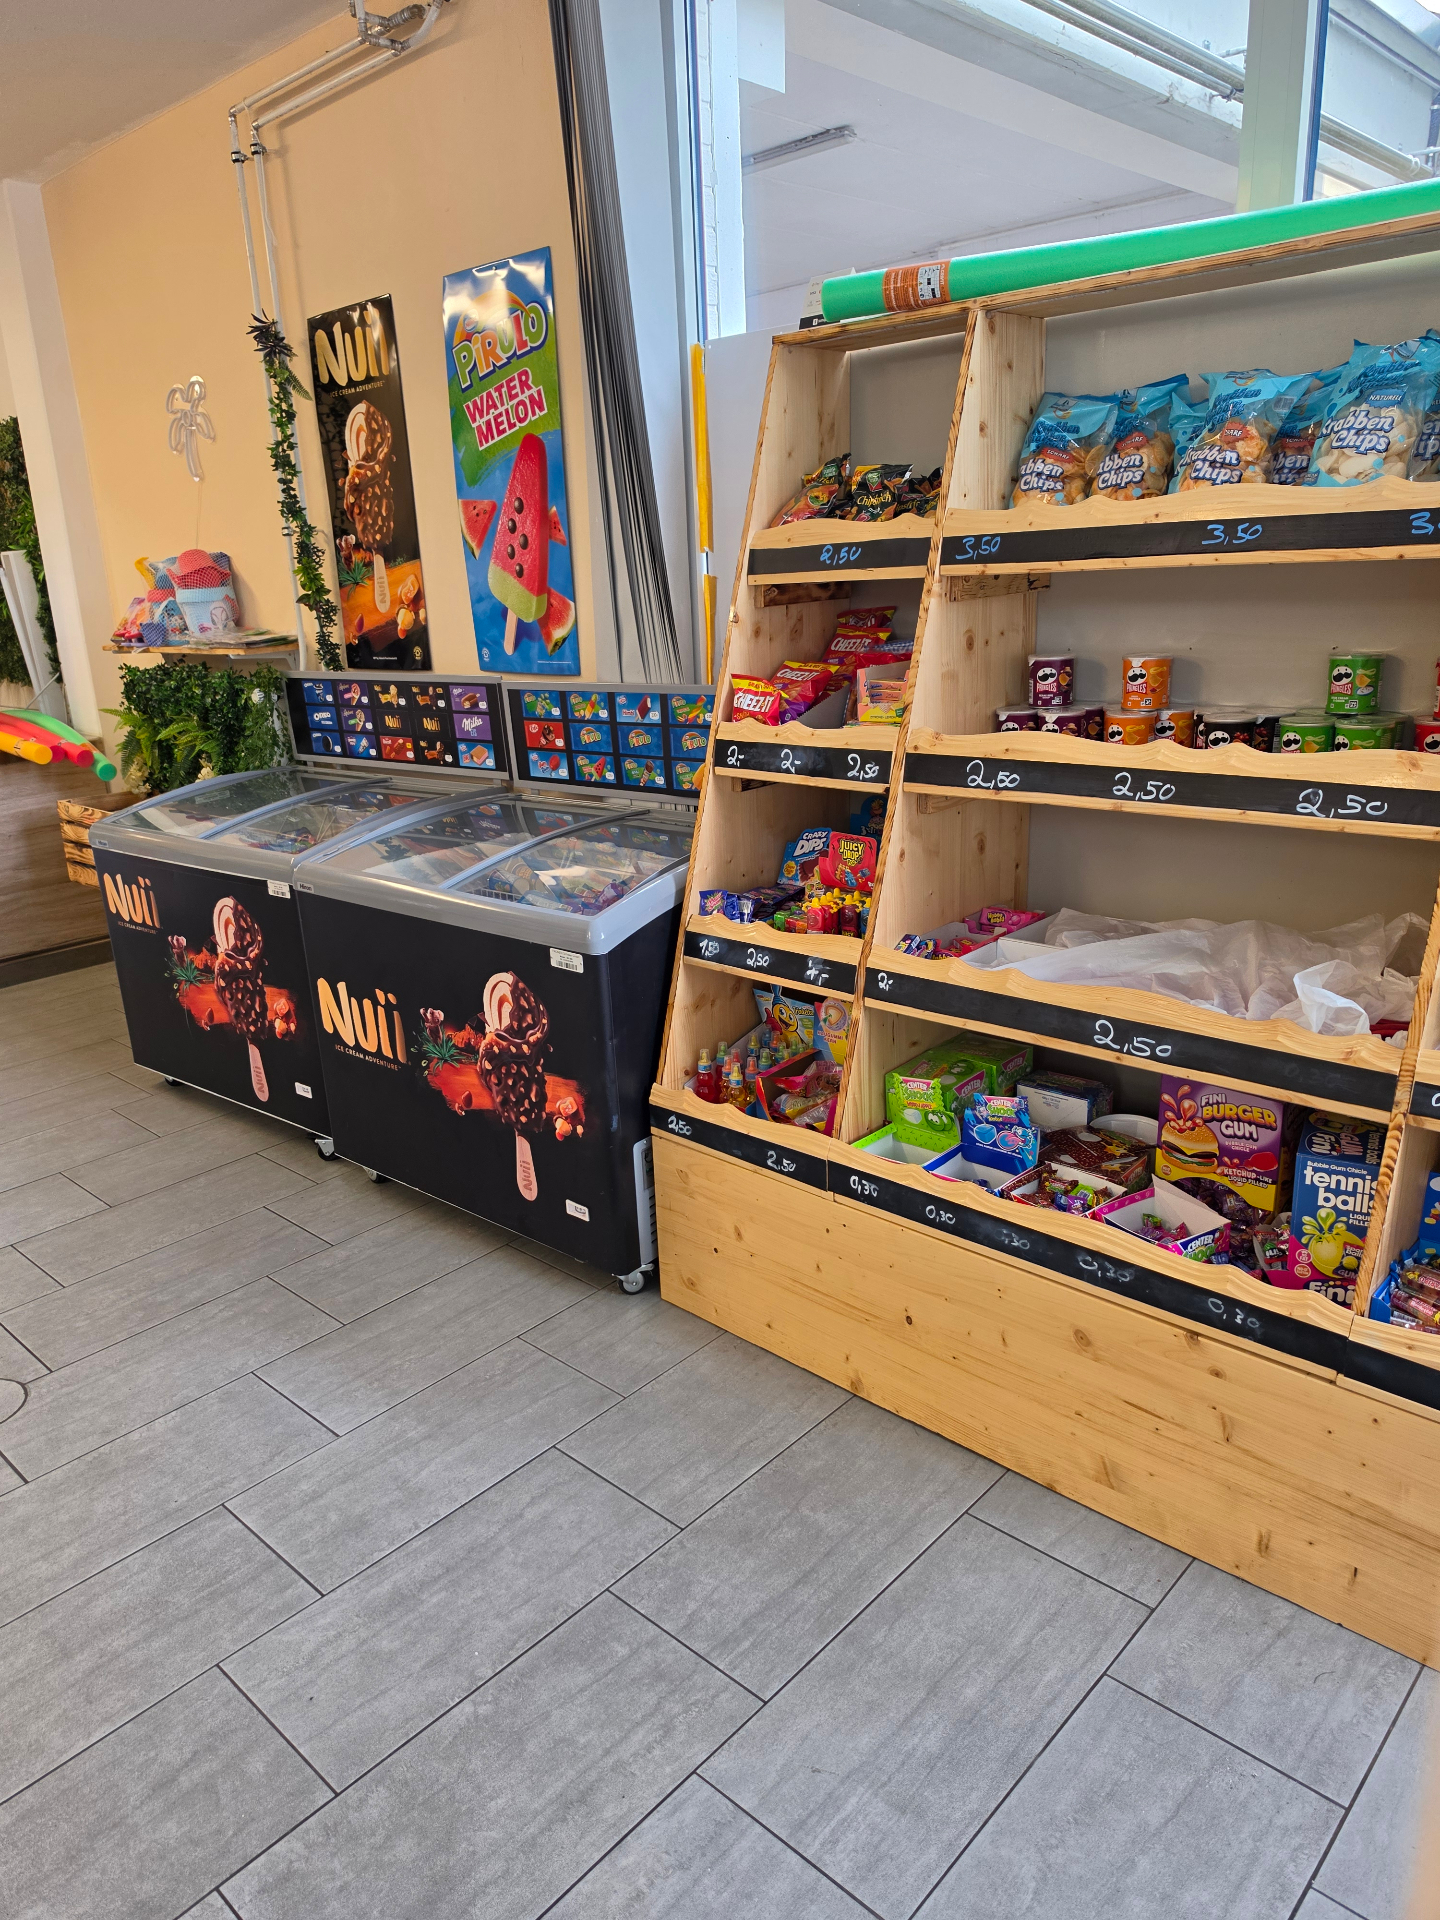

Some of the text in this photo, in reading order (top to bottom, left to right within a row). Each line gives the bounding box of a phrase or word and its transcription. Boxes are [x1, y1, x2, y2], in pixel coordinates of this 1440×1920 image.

[315, 308, 389, 386] Nuii
[339, 387, 355, 396] CREAM
[356, 381, 384, 392] ADVENTURE
[463, 368, 532, 427] WATER
[474, 386, 548, 450] MELON
[1331, 427, 1390, 455] Chips
[1020, 458, 1064, 477] abben
[1098, 453, 1143, 475] abben
[1190, 461, 1243, 485] Chips
[1020, 473, 1064, 492] Chips
[1098, 470, 1145, 490] Chips
[1201, 523, 1263, 545] 3,50
[820, 545, 862, 566] 2,50
[955, 535, 1001, 560] 3,50
[1036, 682, 1058, 693] PRINGLES
[1126, 683, 1147, 694] PRINGLES
[1330, 682, 1353, 695] PRINGLES
[385, 715, 401, 729] Nuii
[423, 717, 440, 731] Nuii
[462, 716, 483, 731] Milka
[847, 753, 880, 779] 2,50
[1112, 772, 1176, 801] 2,50
[1295, 788, 1388, 818] 2,50
[802, 831, 828, 840] CRAZY
[793, 838, 827, 856] DIPS
[839, 840, 865, 855] JUICY
[843, 850, 859, 860] DROP
[103, 872, 161, 929] Nuii
[746, 948, 770, 967] 2,50
[317, 977, 407, 1064] Nuii
[1093, 1019, 1172, 1057] 2,50
[335, 1044, 398, 1071] ICE CREAM ADVENTURE
[906, 1081, 930, 1091] CENTER
[961, 1078, 981, 1097] CENTER
[1201, 1093, 1227, 1106] FINI
[667, 1115, 692, 1136] 2,50
[1202, 1104, 1277, 1130] BURGER
[1220, 1121, 1258, 1141] GUM
[766, 1150, 796, 1172] 2,50
[1307, 1160, 1368, 1175] Bubble Gum Chicle
[520, 1160, 533, 1192] Nuii
[1228, 1175, 1268, 1189] LIQUID FILLED
[925, 1205, 956, 1225] 0,30
[1349, 1213, 1371, 1222] LIQUI
[1349, 1218, 1370, 1226] FILLE
[1187, 1234, 1214, 1252] CENTER
[1346, 1244, 1363, 1253] Spor
[1207, 1298, 1261, 1328] 0,30
